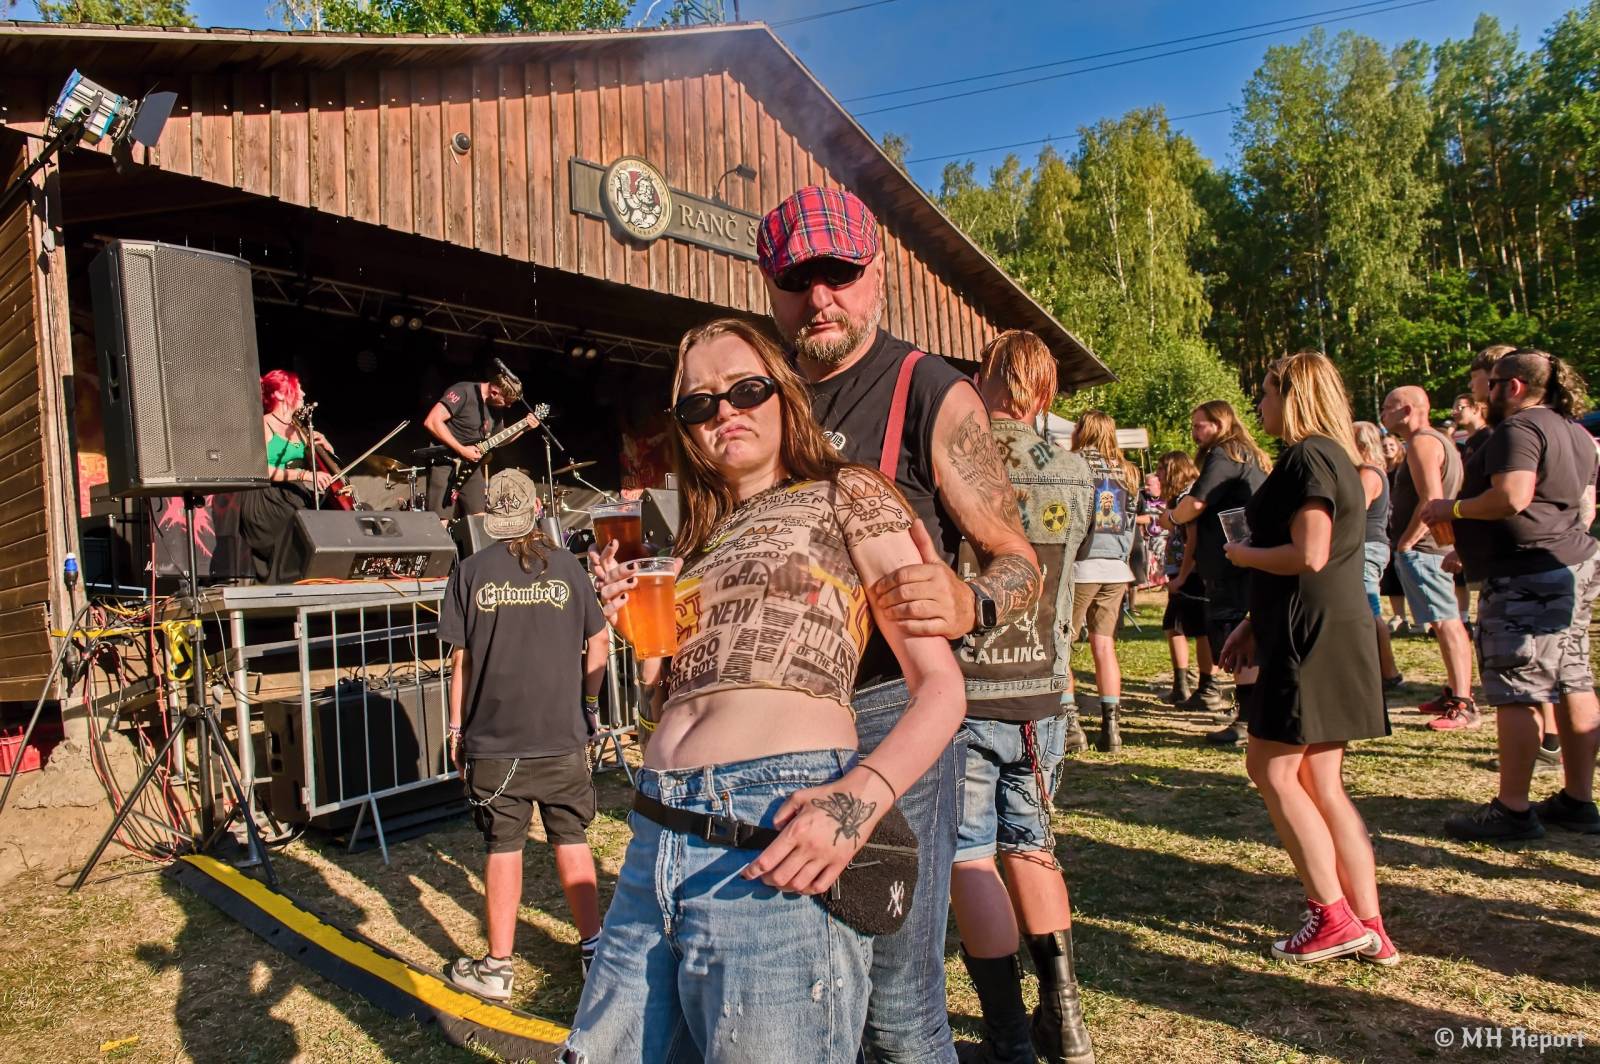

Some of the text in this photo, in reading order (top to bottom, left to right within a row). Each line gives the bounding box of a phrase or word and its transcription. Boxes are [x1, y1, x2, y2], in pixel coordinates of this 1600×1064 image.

[679, 204, 738, 242] RANČ
[706, 598, 759, 629] NEW
[691, 654, 719, 680] BOYS
[796, 645, 813, 658] OF
[813, 650, 832, 670] THE
[960, 643, 1048, 665] CALLING
